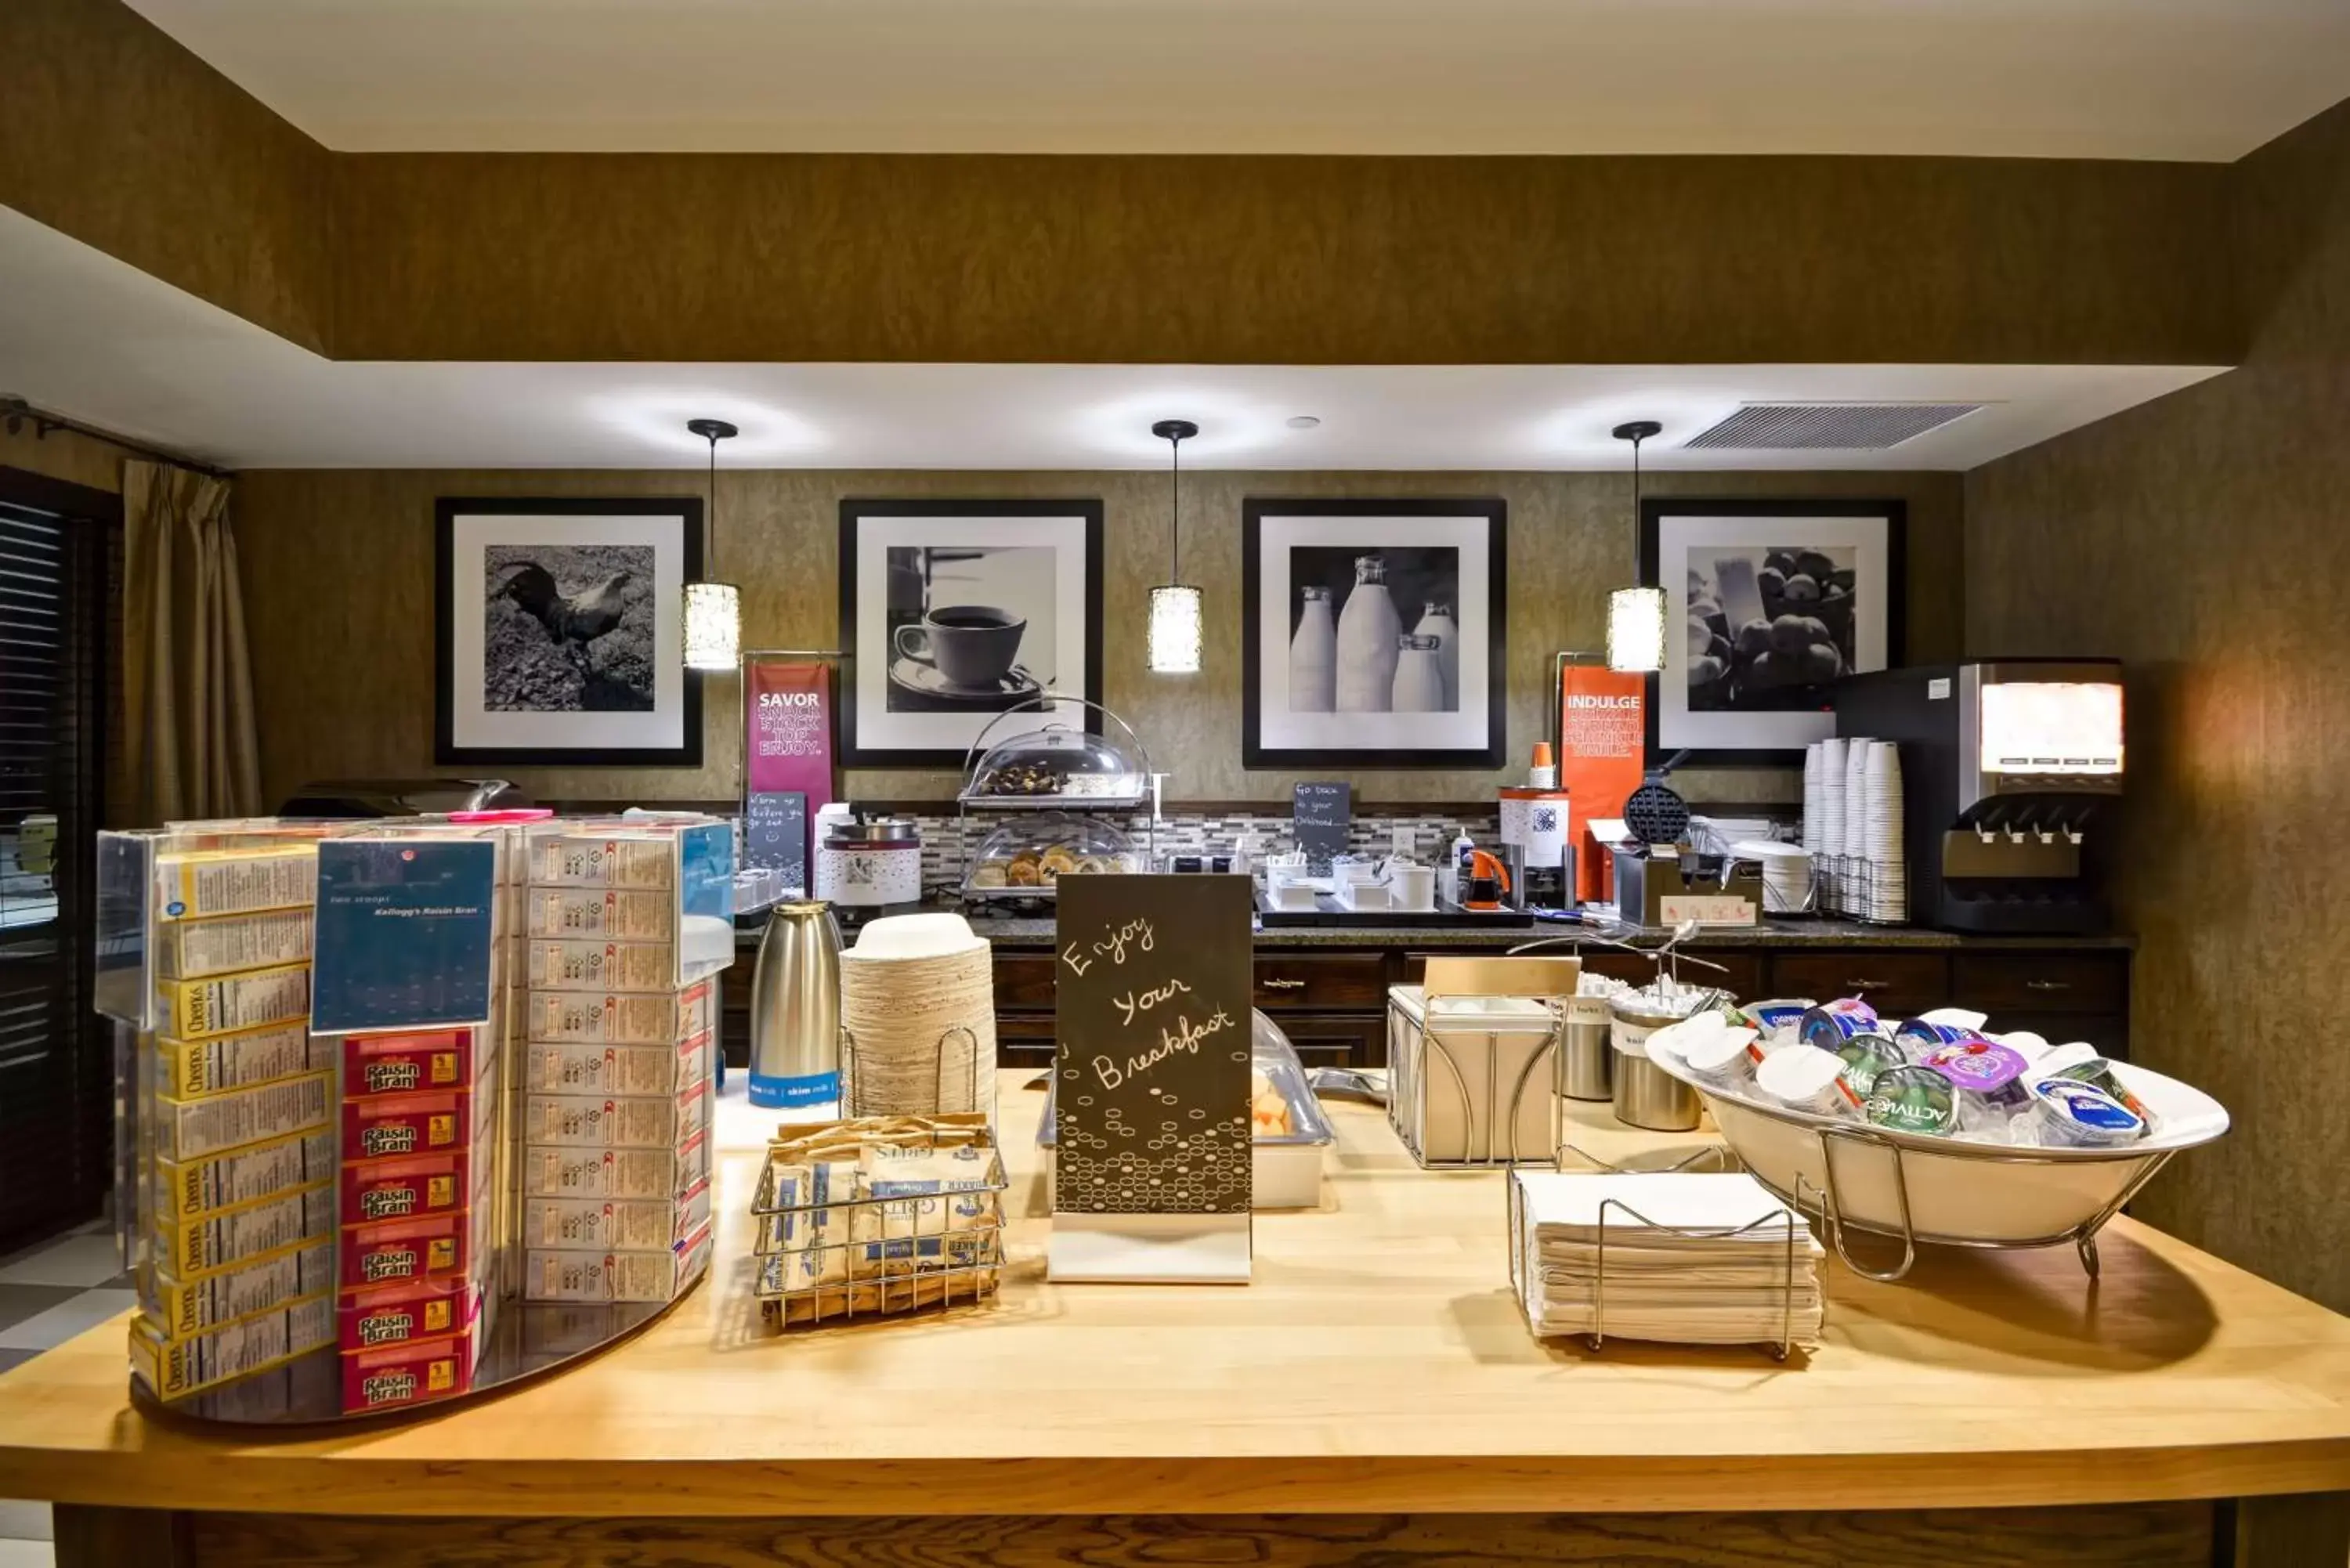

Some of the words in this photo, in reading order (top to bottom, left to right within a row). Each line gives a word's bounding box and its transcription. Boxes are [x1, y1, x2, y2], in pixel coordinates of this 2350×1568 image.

[759, 693, 819, 706] SAVOR
[1567, 695, 1641, 709] INDULGE
[772, 728, 808, 741] TOP
[758, 740, 822, 756] ENJOY.
[422, 905, 453, 916] Raisin
[455, 905, 479, 916] Bran
[1062, 917, 1154, 977] Enjoy
[1091, 1002, 1236, 1090] Breakfast
[365, 1063, 420, 1082] Raisin
[371, 1075, 414, 1092] Bran
[787, 1086, 812, 1096] skim
[362, 1126, 417, 1145] Raisin
[367, 1137, 412, 1157] Bran
[361, 1189, 416, 1210] Raisin
[367, 1201, 411, 1219] Bran
[362, 1252, 417, 1272] Raisin
[367, 1263, 411, 1282] Bran
[359, 1313, 413, 1335] Raisin
[364, 1326, 409, 1346] Bran
[363, 1374, 417, 1395] Raisin
[368, 1387, 412, 1406] Bran
